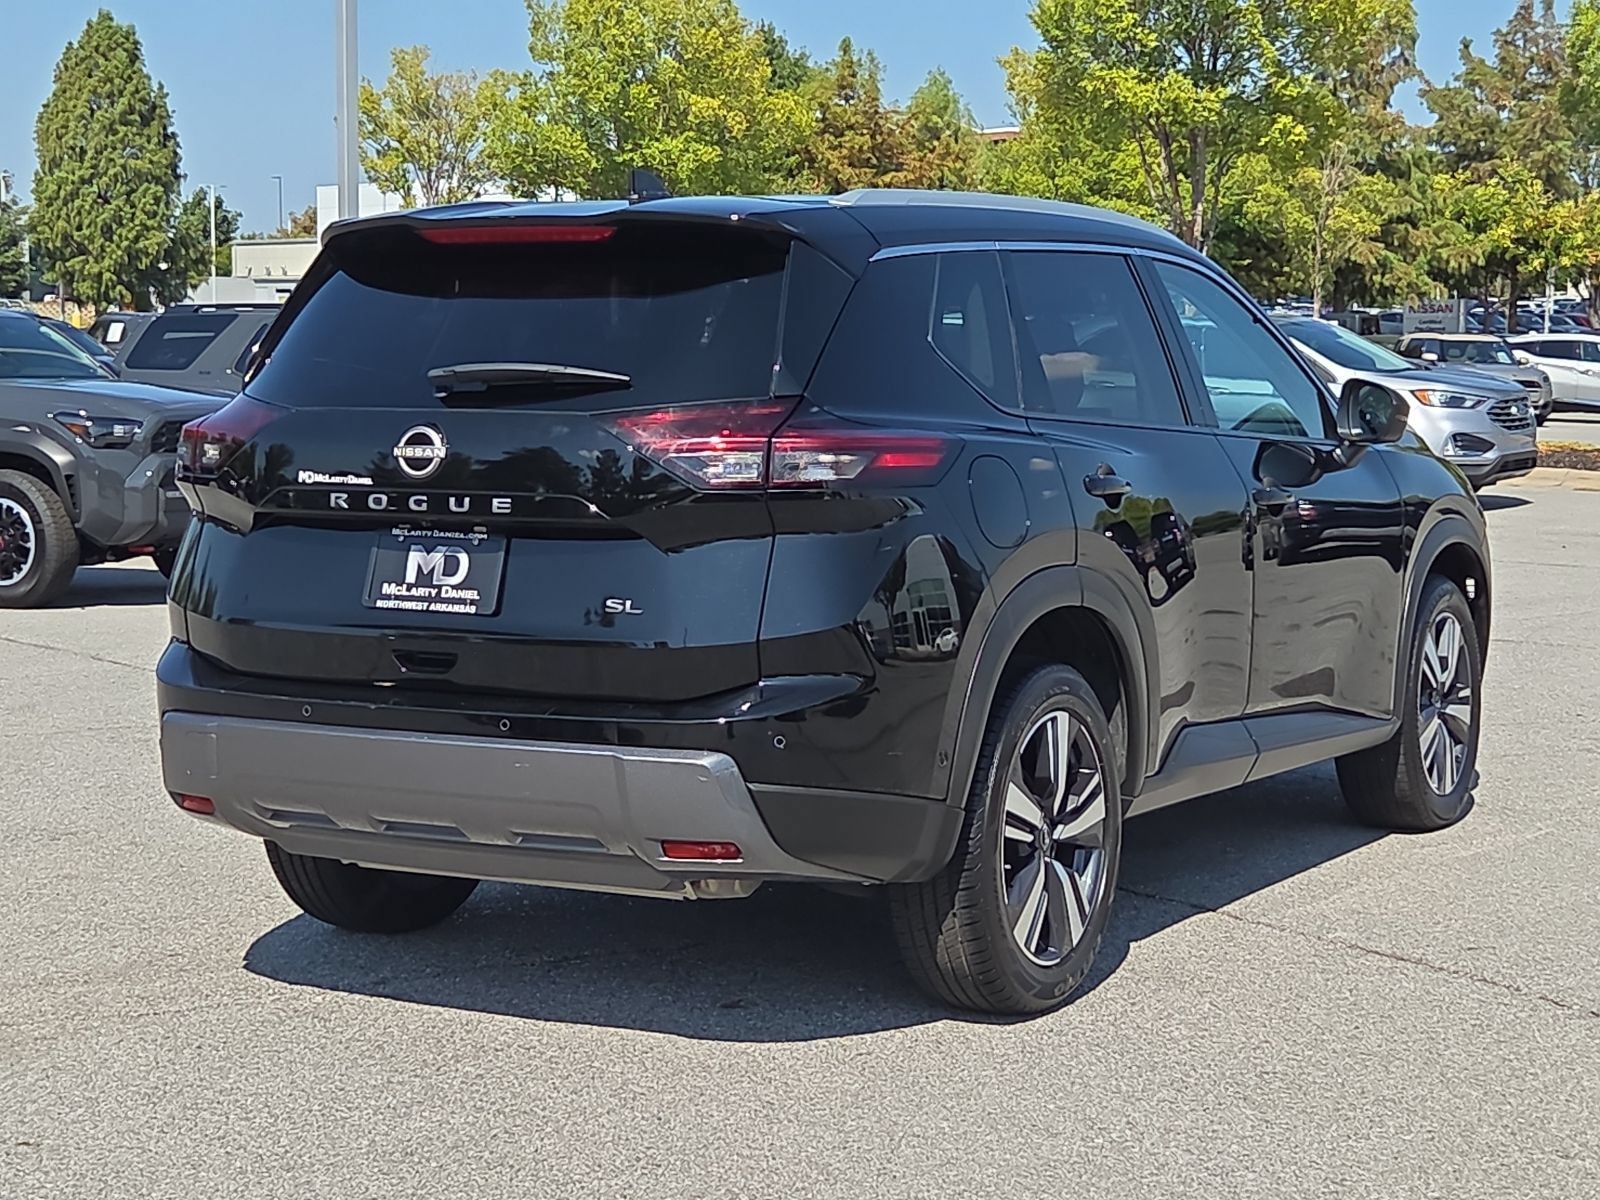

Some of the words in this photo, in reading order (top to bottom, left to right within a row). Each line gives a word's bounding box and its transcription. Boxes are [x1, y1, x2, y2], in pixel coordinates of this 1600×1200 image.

[393, 446, 446, 458] NISSAN
[329, 492, 512, 513] ROGUE
[404, 544, 470, 586] MD
[440, 586, 480, 600] DANIEL
[375, 599, 429, 611] NORTHWEST
[428, 602, 477, 614] ARKANSAS
[604, 598, 644, 614] SL
